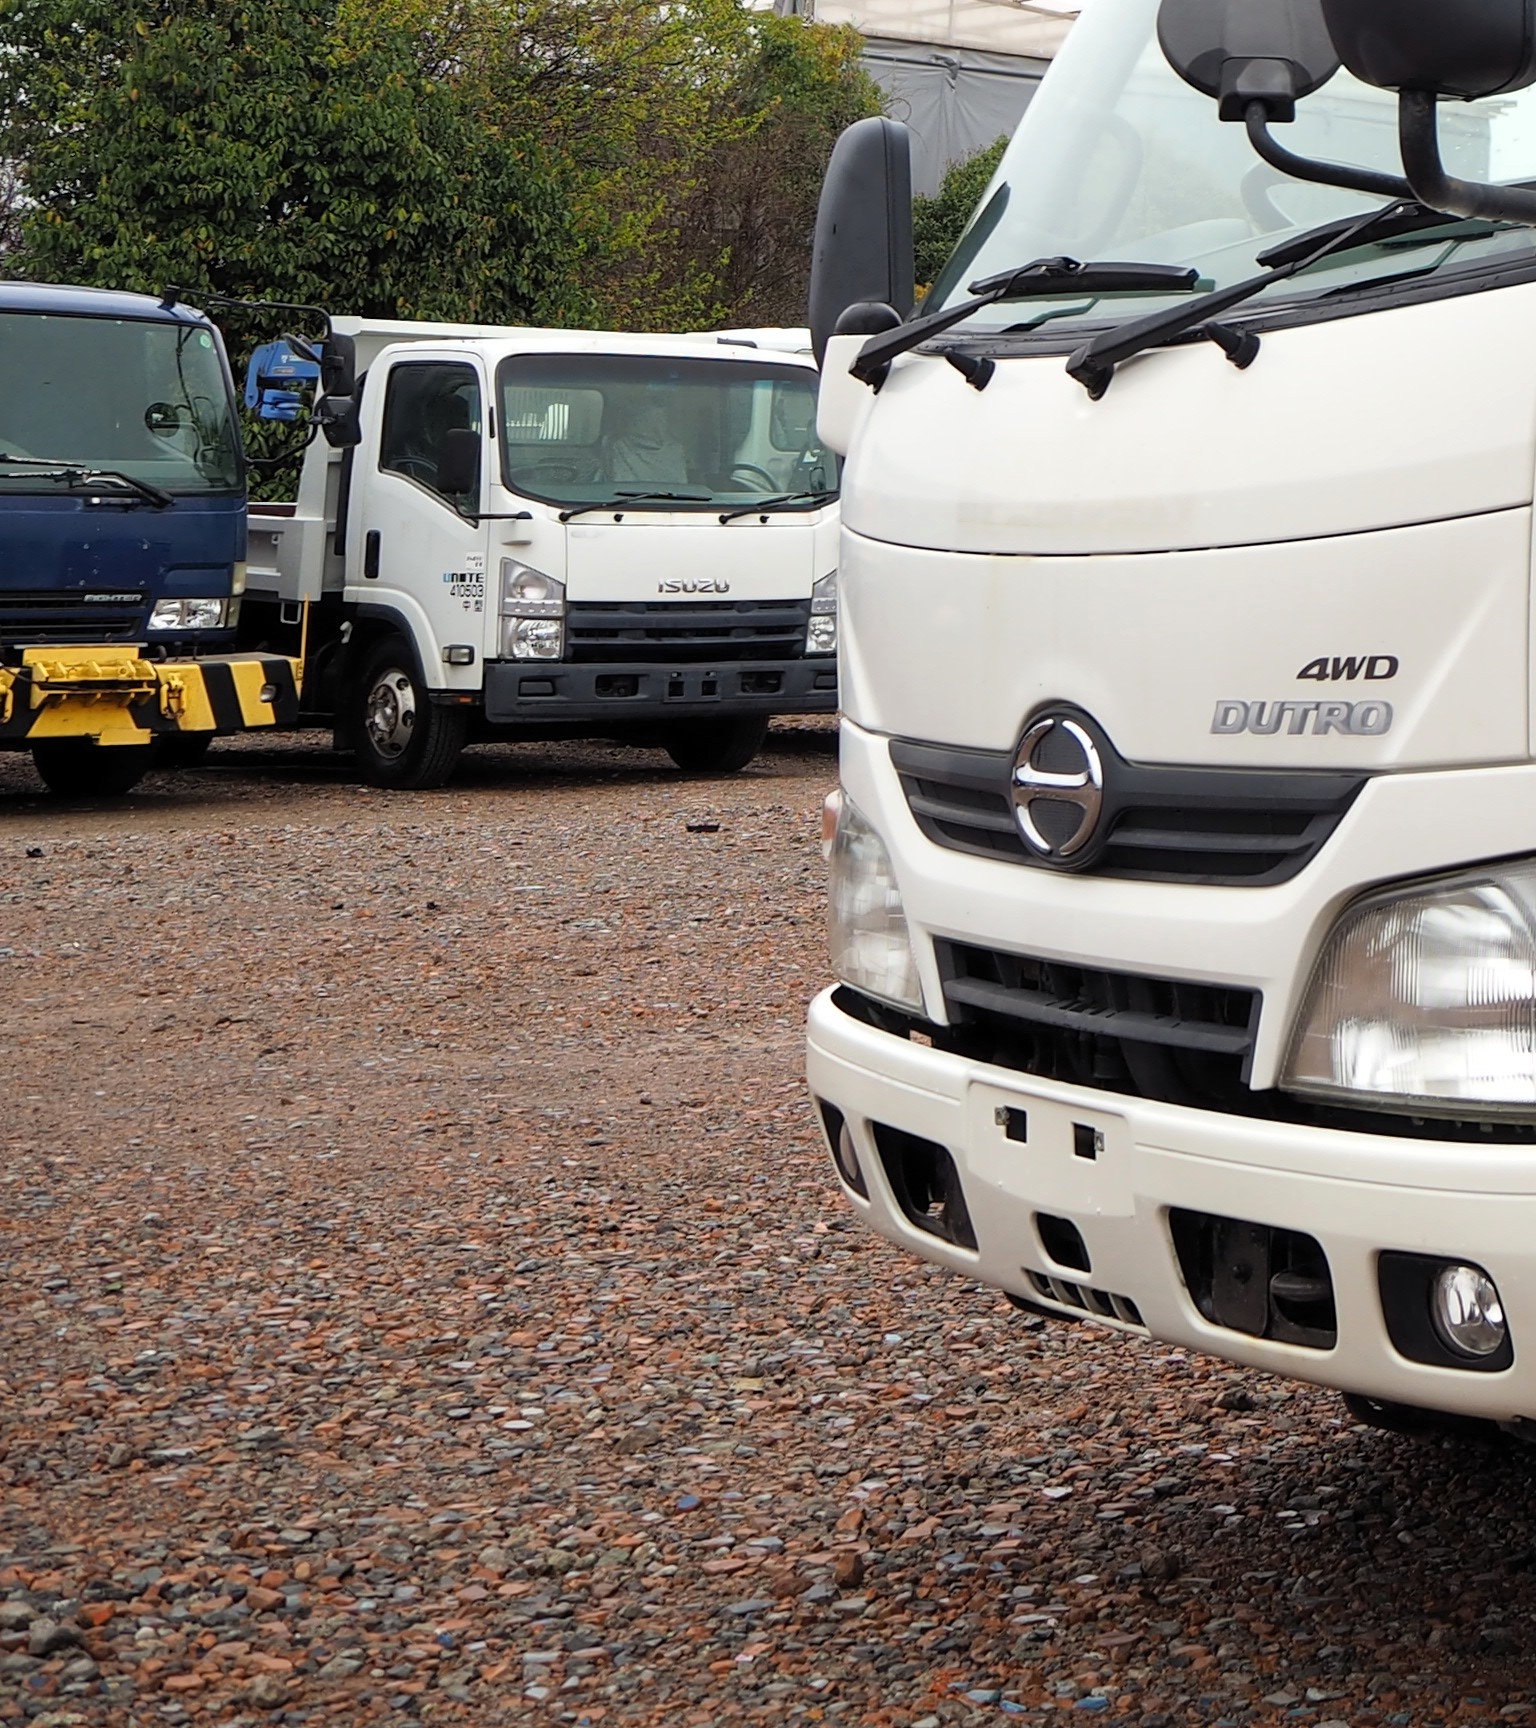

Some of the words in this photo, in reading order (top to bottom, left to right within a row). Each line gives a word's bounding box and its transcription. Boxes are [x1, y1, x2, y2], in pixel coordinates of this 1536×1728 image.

[658, 578, 730, 593] ISUZU
[1296, 655, 1399, 682] 4WD
[1209, 699, 1394, 736] DUTRO
